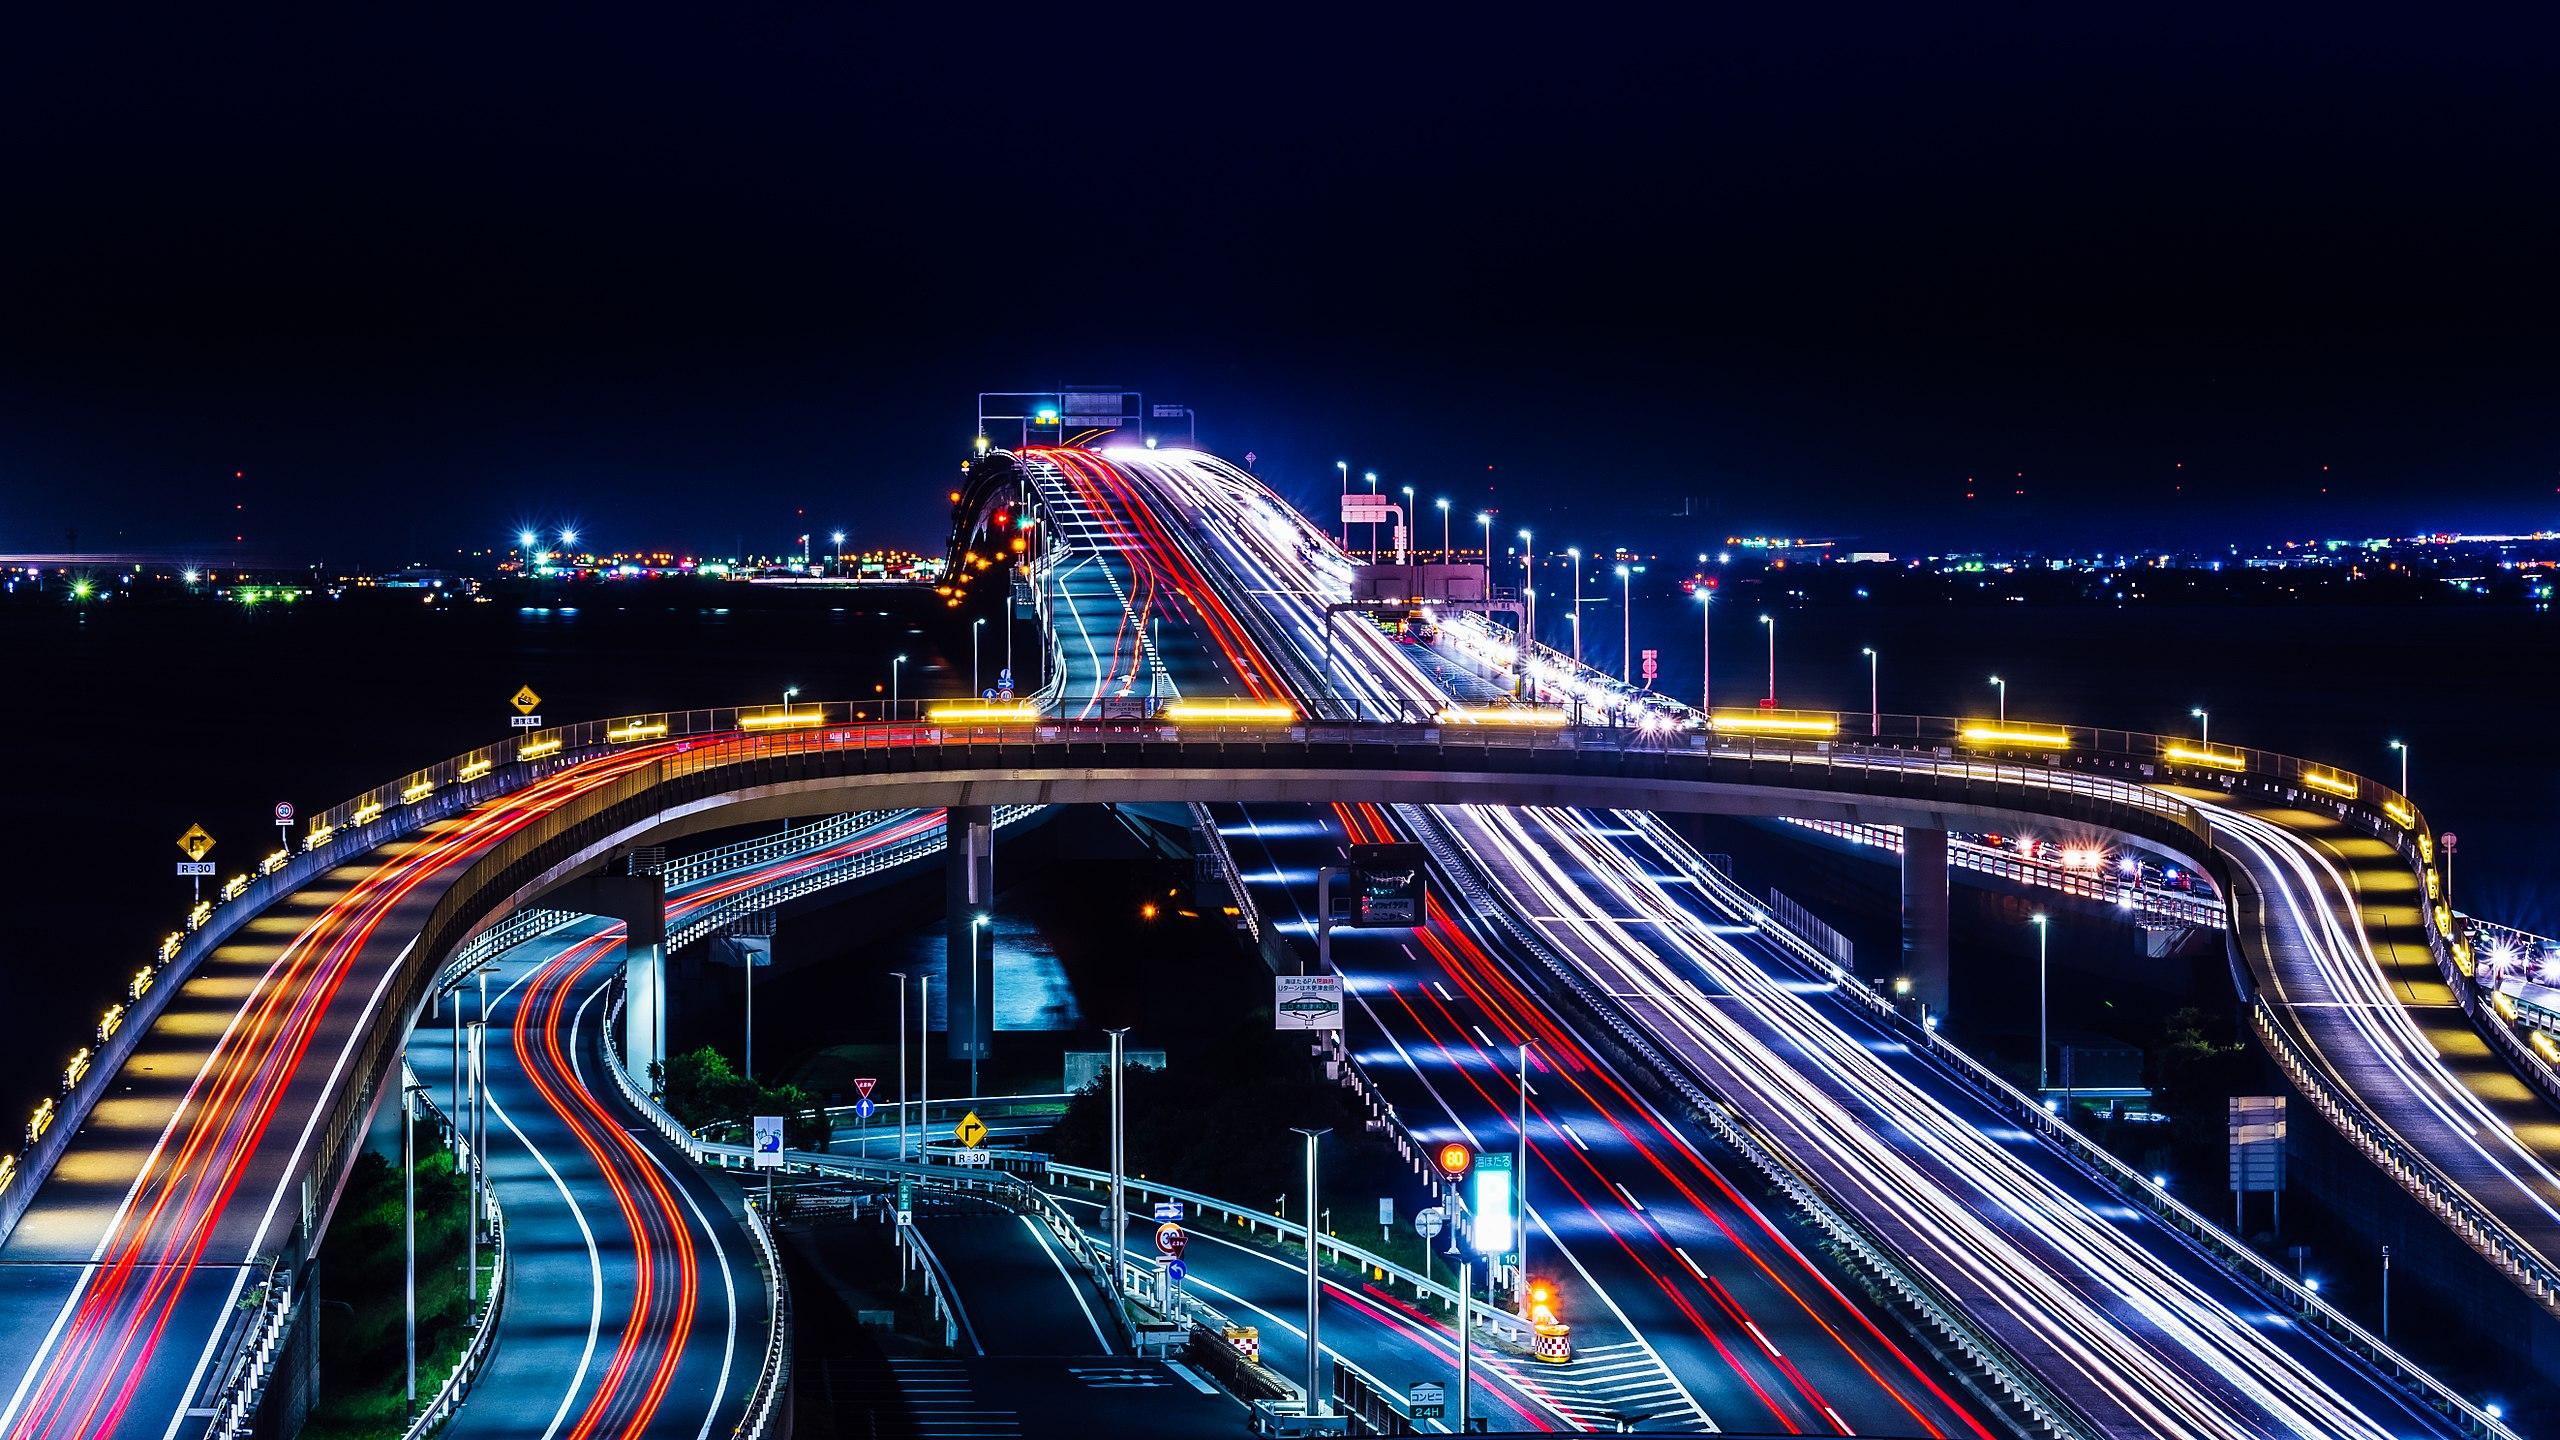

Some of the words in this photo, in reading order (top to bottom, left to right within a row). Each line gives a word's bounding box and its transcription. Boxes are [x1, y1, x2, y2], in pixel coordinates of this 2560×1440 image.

[279, 806, 290, 815] 30
[181, 863, 211, 873] R=30
[959, 1153, 986, 1163] R=30
[1446, 1151, 1464, 1166] 80
[1475, 1155, 1511, 1168] 海ほたる
[1505, 1254, 1517, 1264] 10
[1411, 1392, 1442, 1401] コンビニ
[1415, 1407, 1439, 1417] 24H
